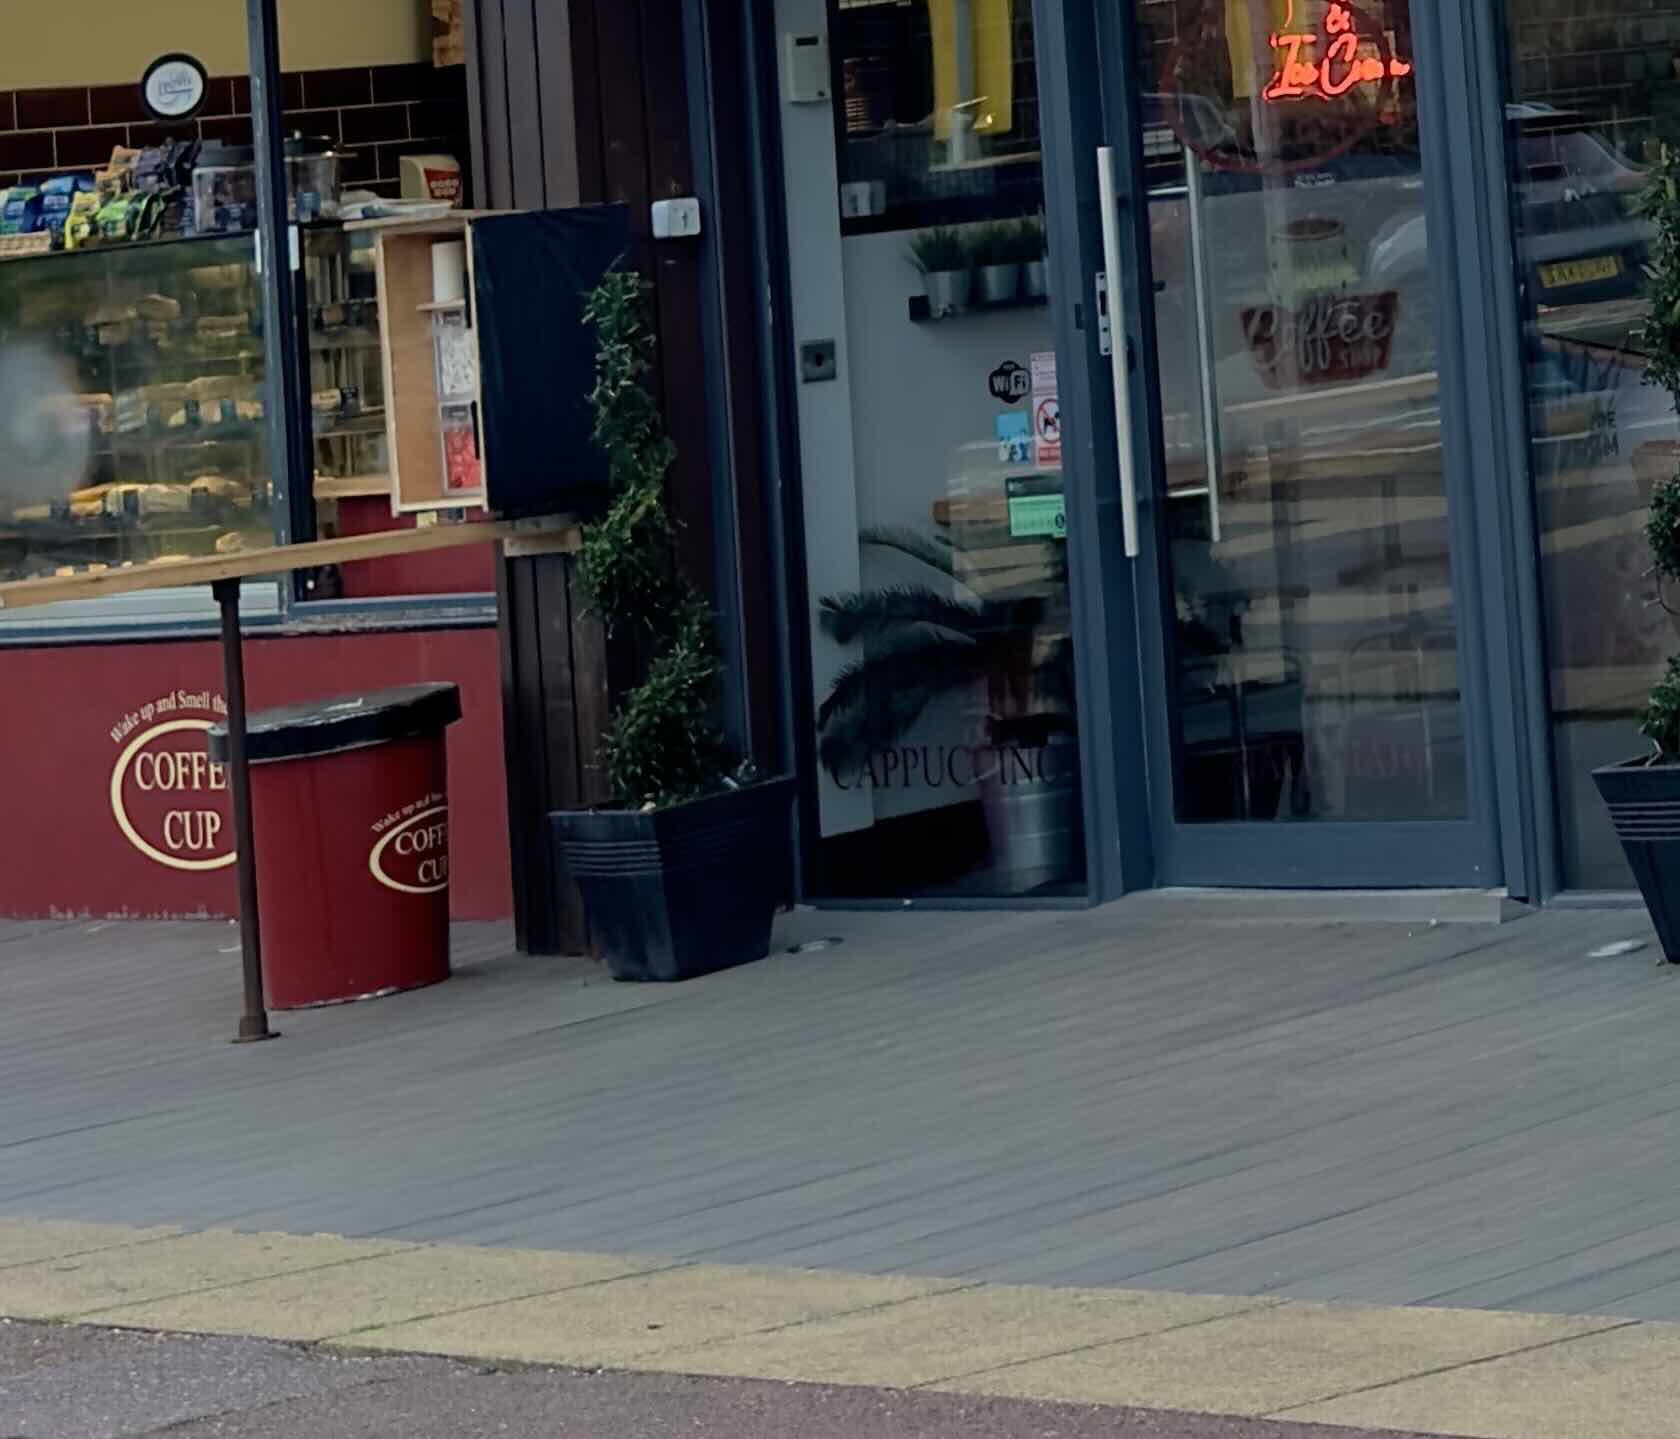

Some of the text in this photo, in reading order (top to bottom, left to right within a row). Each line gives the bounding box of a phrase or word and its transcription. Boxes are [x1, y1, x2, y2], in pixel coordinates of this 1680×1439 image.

[139, 703, 155, 722] up
[156, 691, 177, 713] and
[177, 689, 210, 709] Smell
[135, 751, 229, 791] COFFE
[164, 810, 221, 850] CUP
[394, 823, 448, 856] COFF
